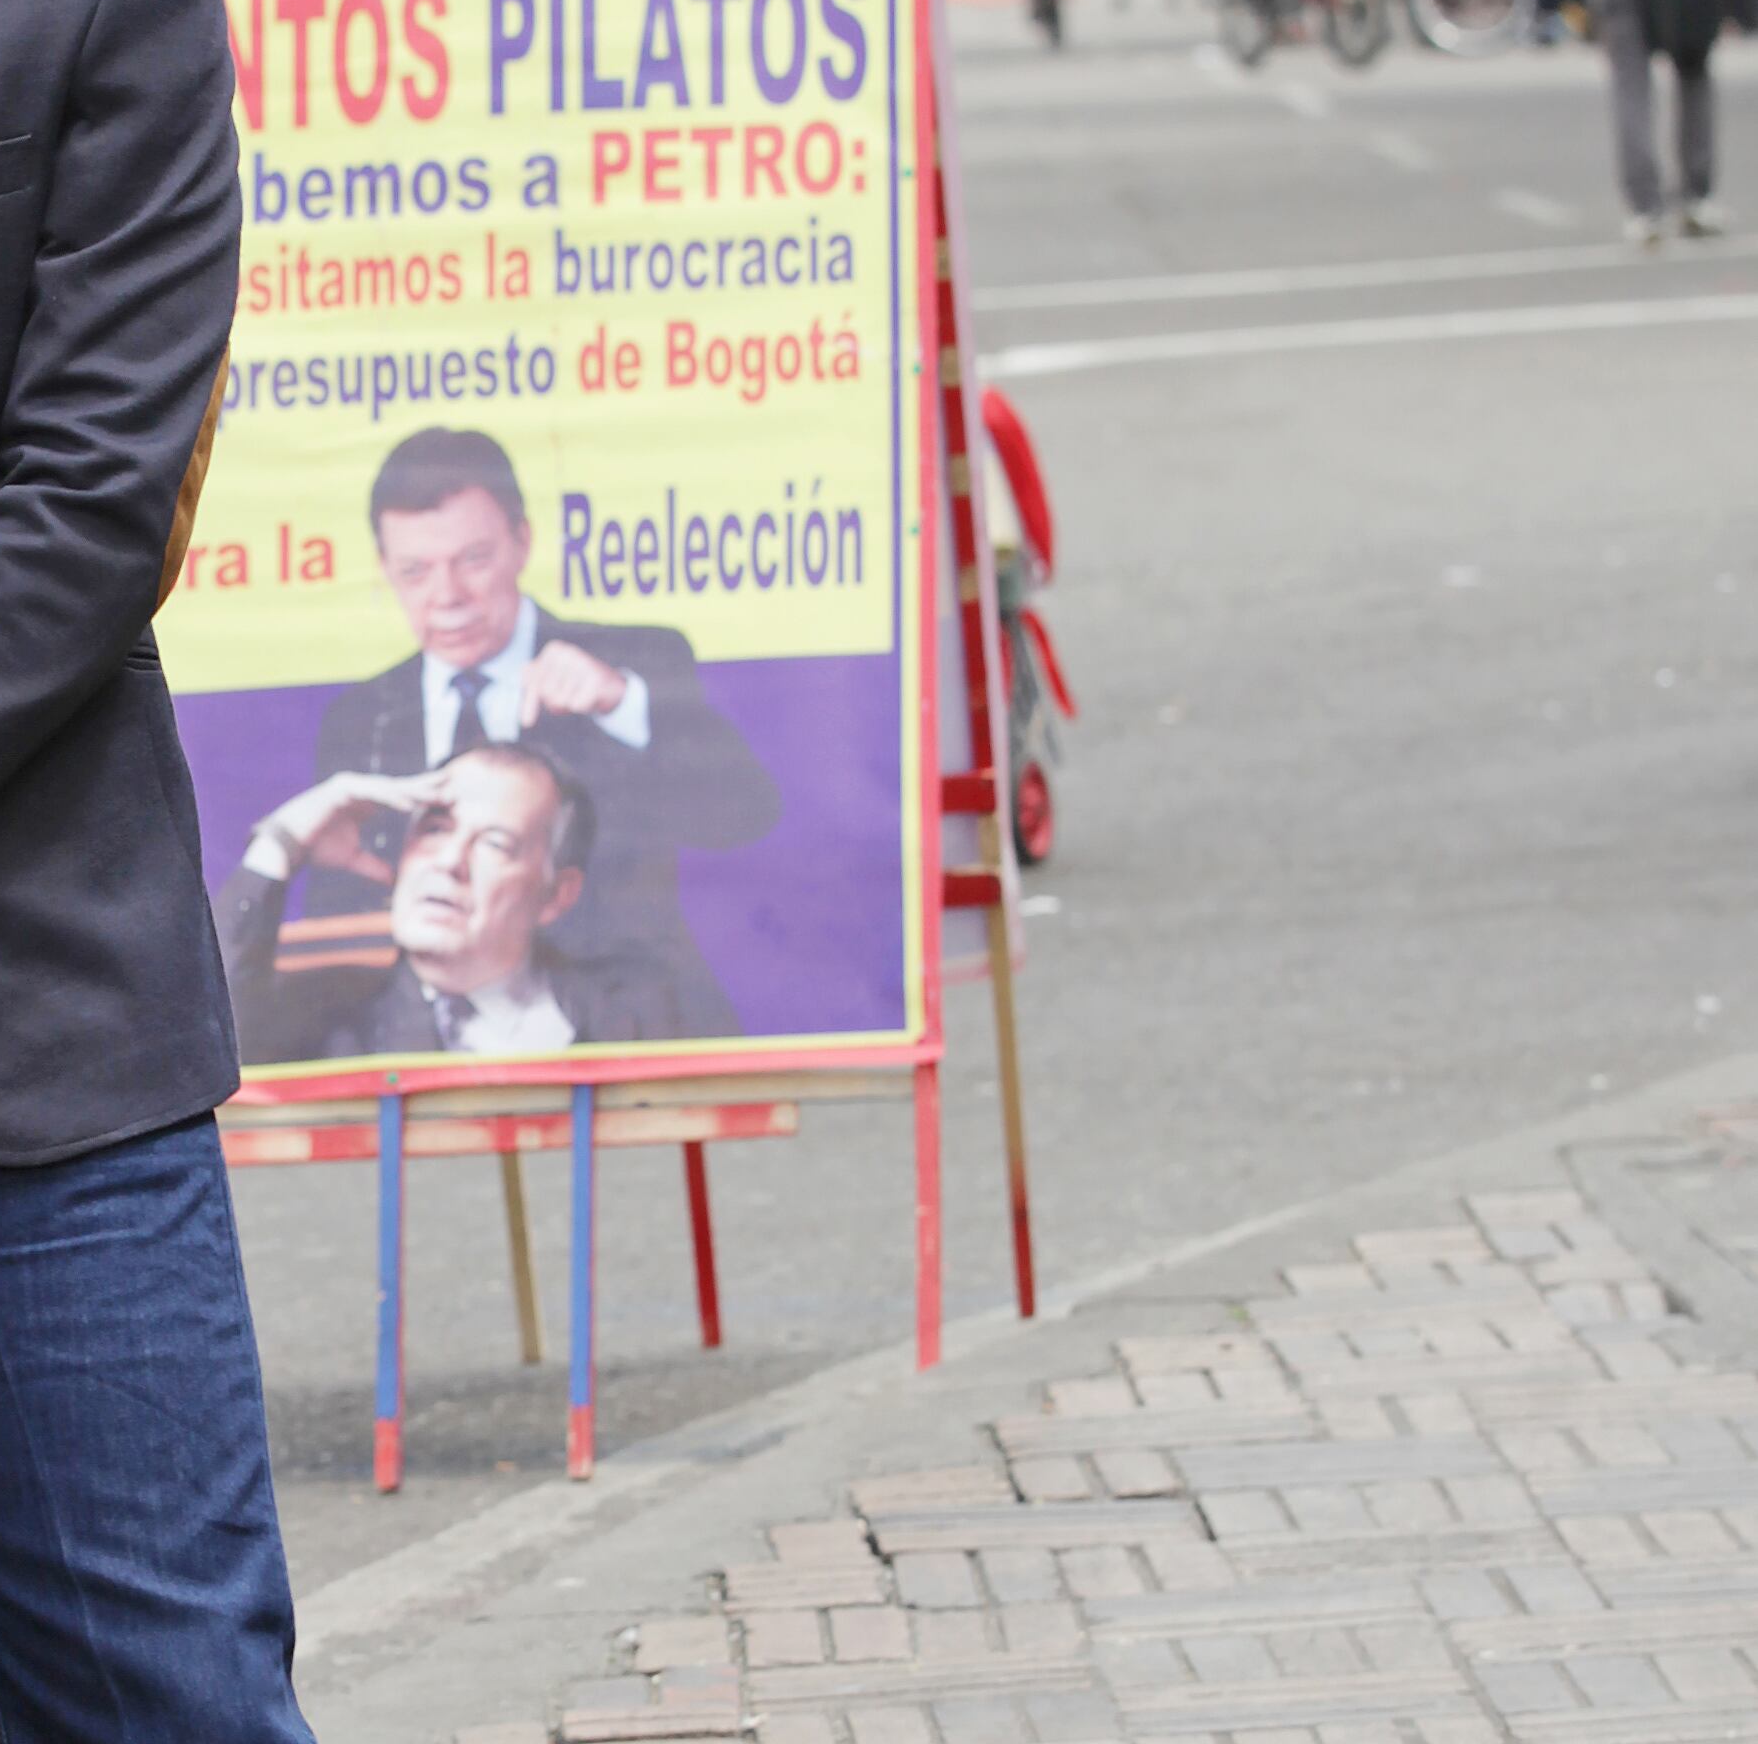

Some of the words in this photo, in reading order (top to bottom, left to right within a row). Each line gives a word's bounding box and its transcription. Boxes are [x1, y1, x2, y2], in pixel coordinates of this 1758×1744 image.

[522, 153, 560, 210] a
[591, 120, 868, 207] PETRO:
[237, 241, 464, 317] sitamos
[485, 231, 533, 302] la
[554, 215, 855, 297] burocracia
[577, 323, 643, 395] de
[664, 311, 863, 405] Bogotá
[278, 522, 336, 585] la
[559, 477, 865, 600] Reelección
